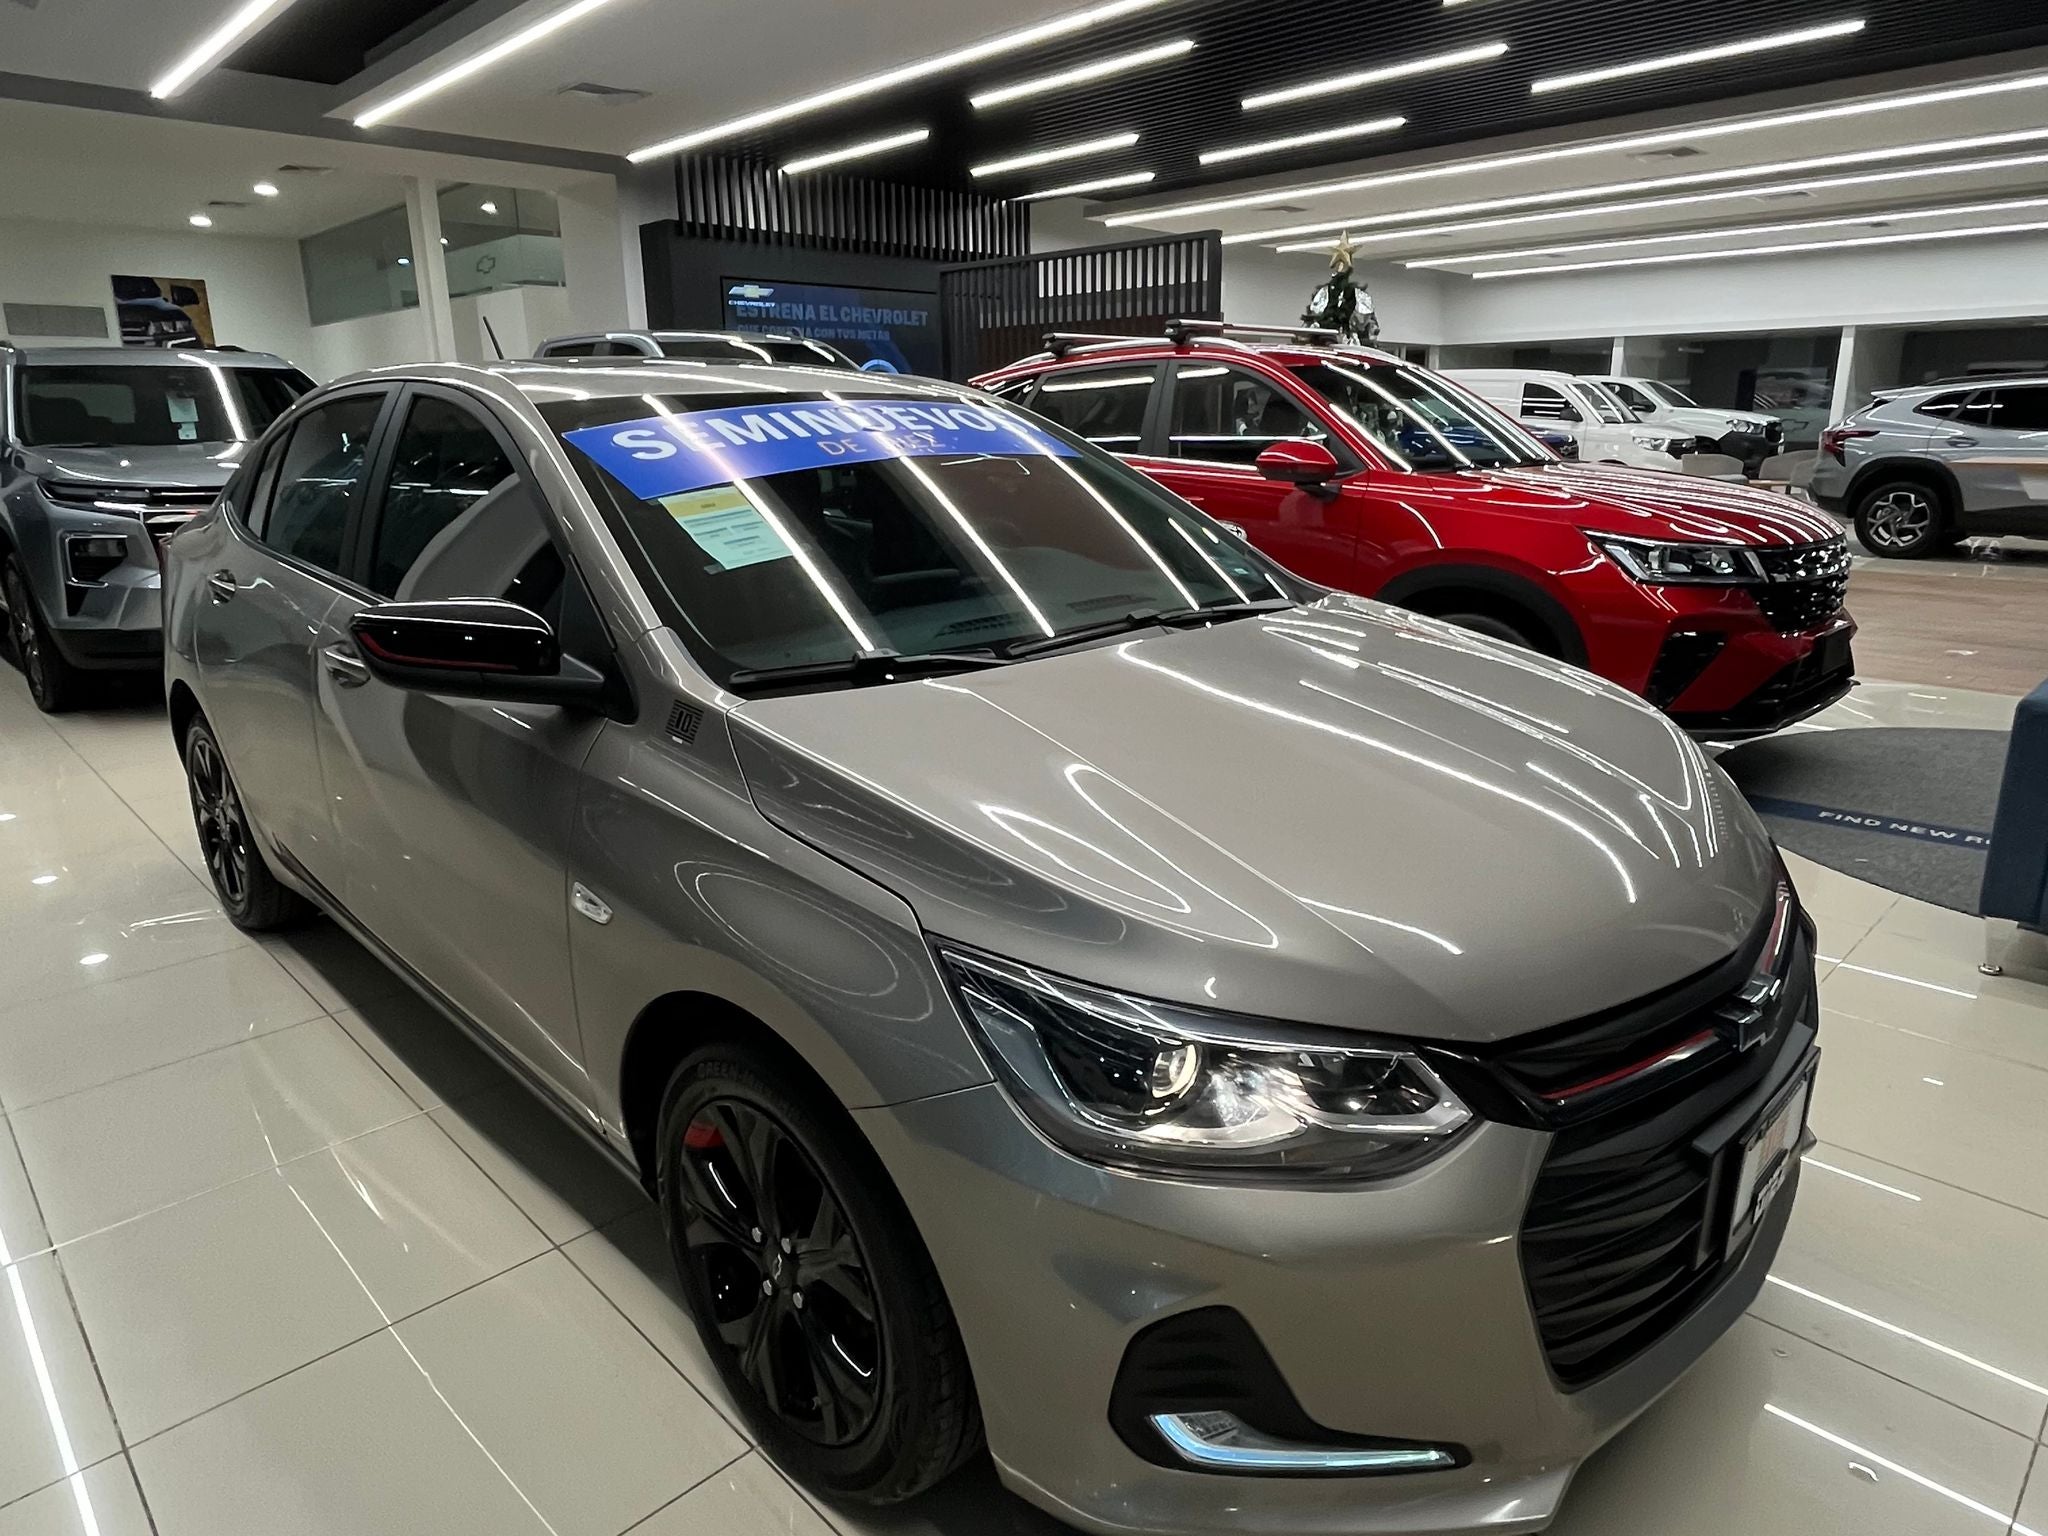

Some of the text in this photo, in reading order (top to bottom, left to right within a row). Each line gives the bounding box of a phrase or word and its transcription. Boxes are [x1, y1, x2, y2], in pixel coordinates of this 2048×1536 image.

[736, 303, 929, 325] ESTRENA EL CHEVROLET
[817, 437, 867, 456] DE
[1818, 810, 1882, 827] FIND
[1889, 823, 1957, 839] NEW
